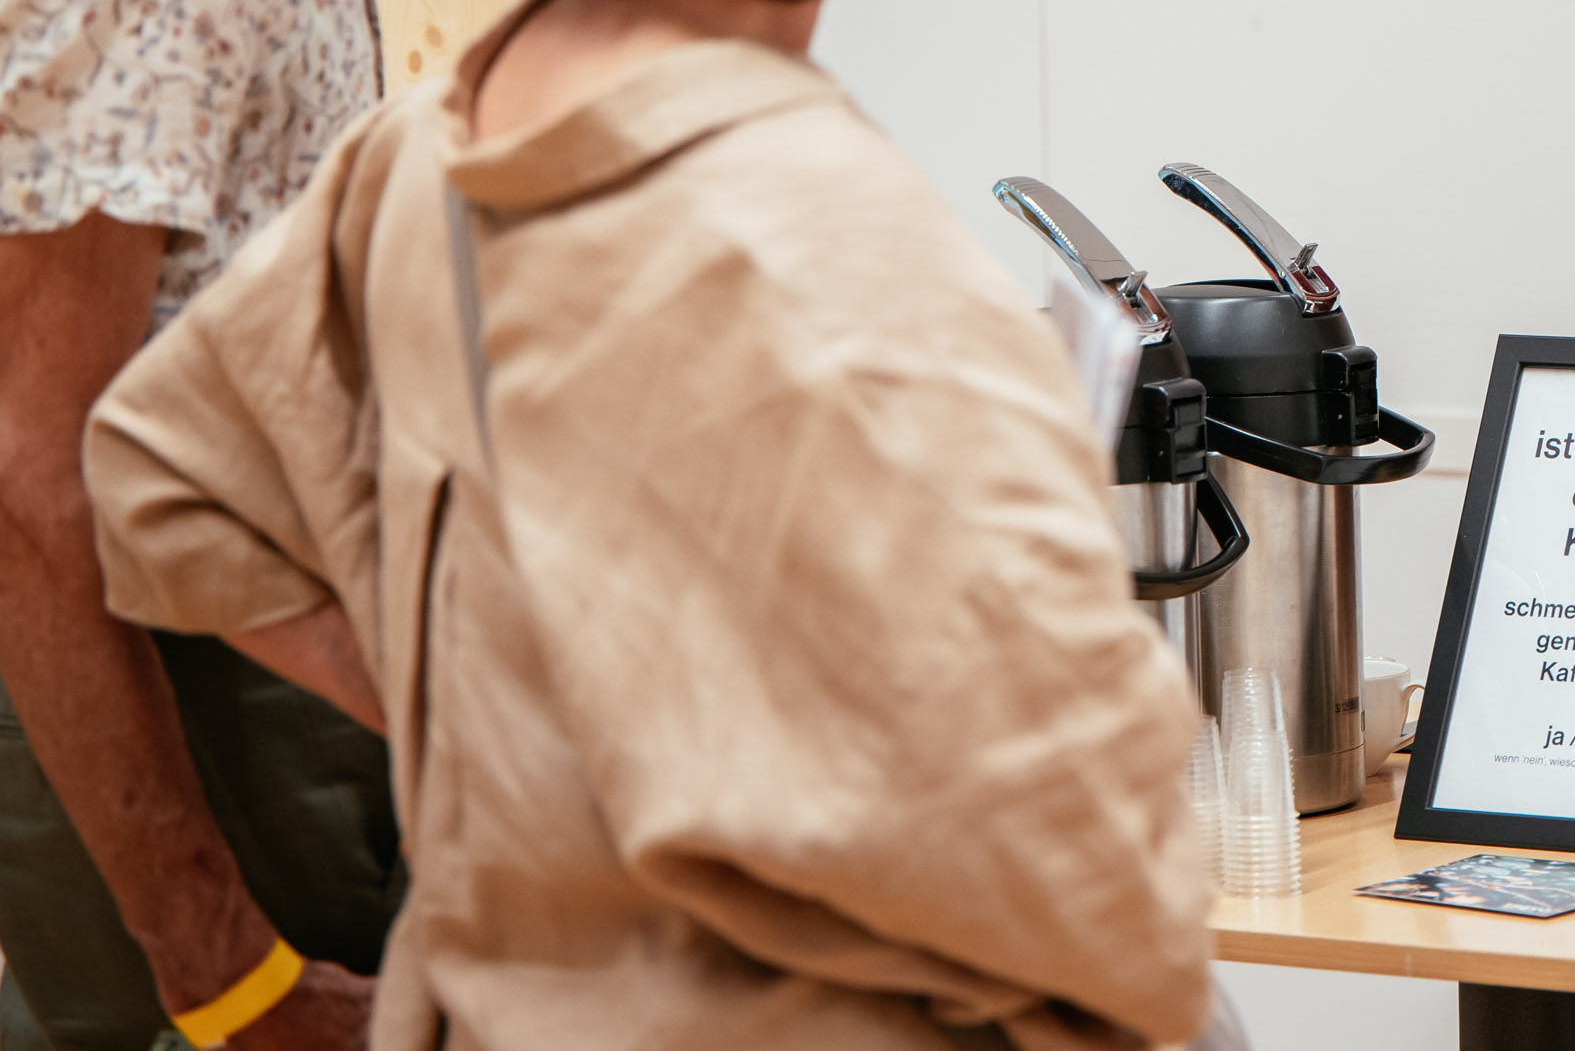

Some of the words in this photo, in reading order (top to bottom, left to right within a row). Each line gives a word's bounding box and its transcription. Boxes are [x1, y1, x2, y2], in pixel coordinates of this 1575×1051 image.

[1535, 430, 1574, 459] ist
[1543, 726, 1564, 748] ja
[1494, 754, 1520, 763] wenn
